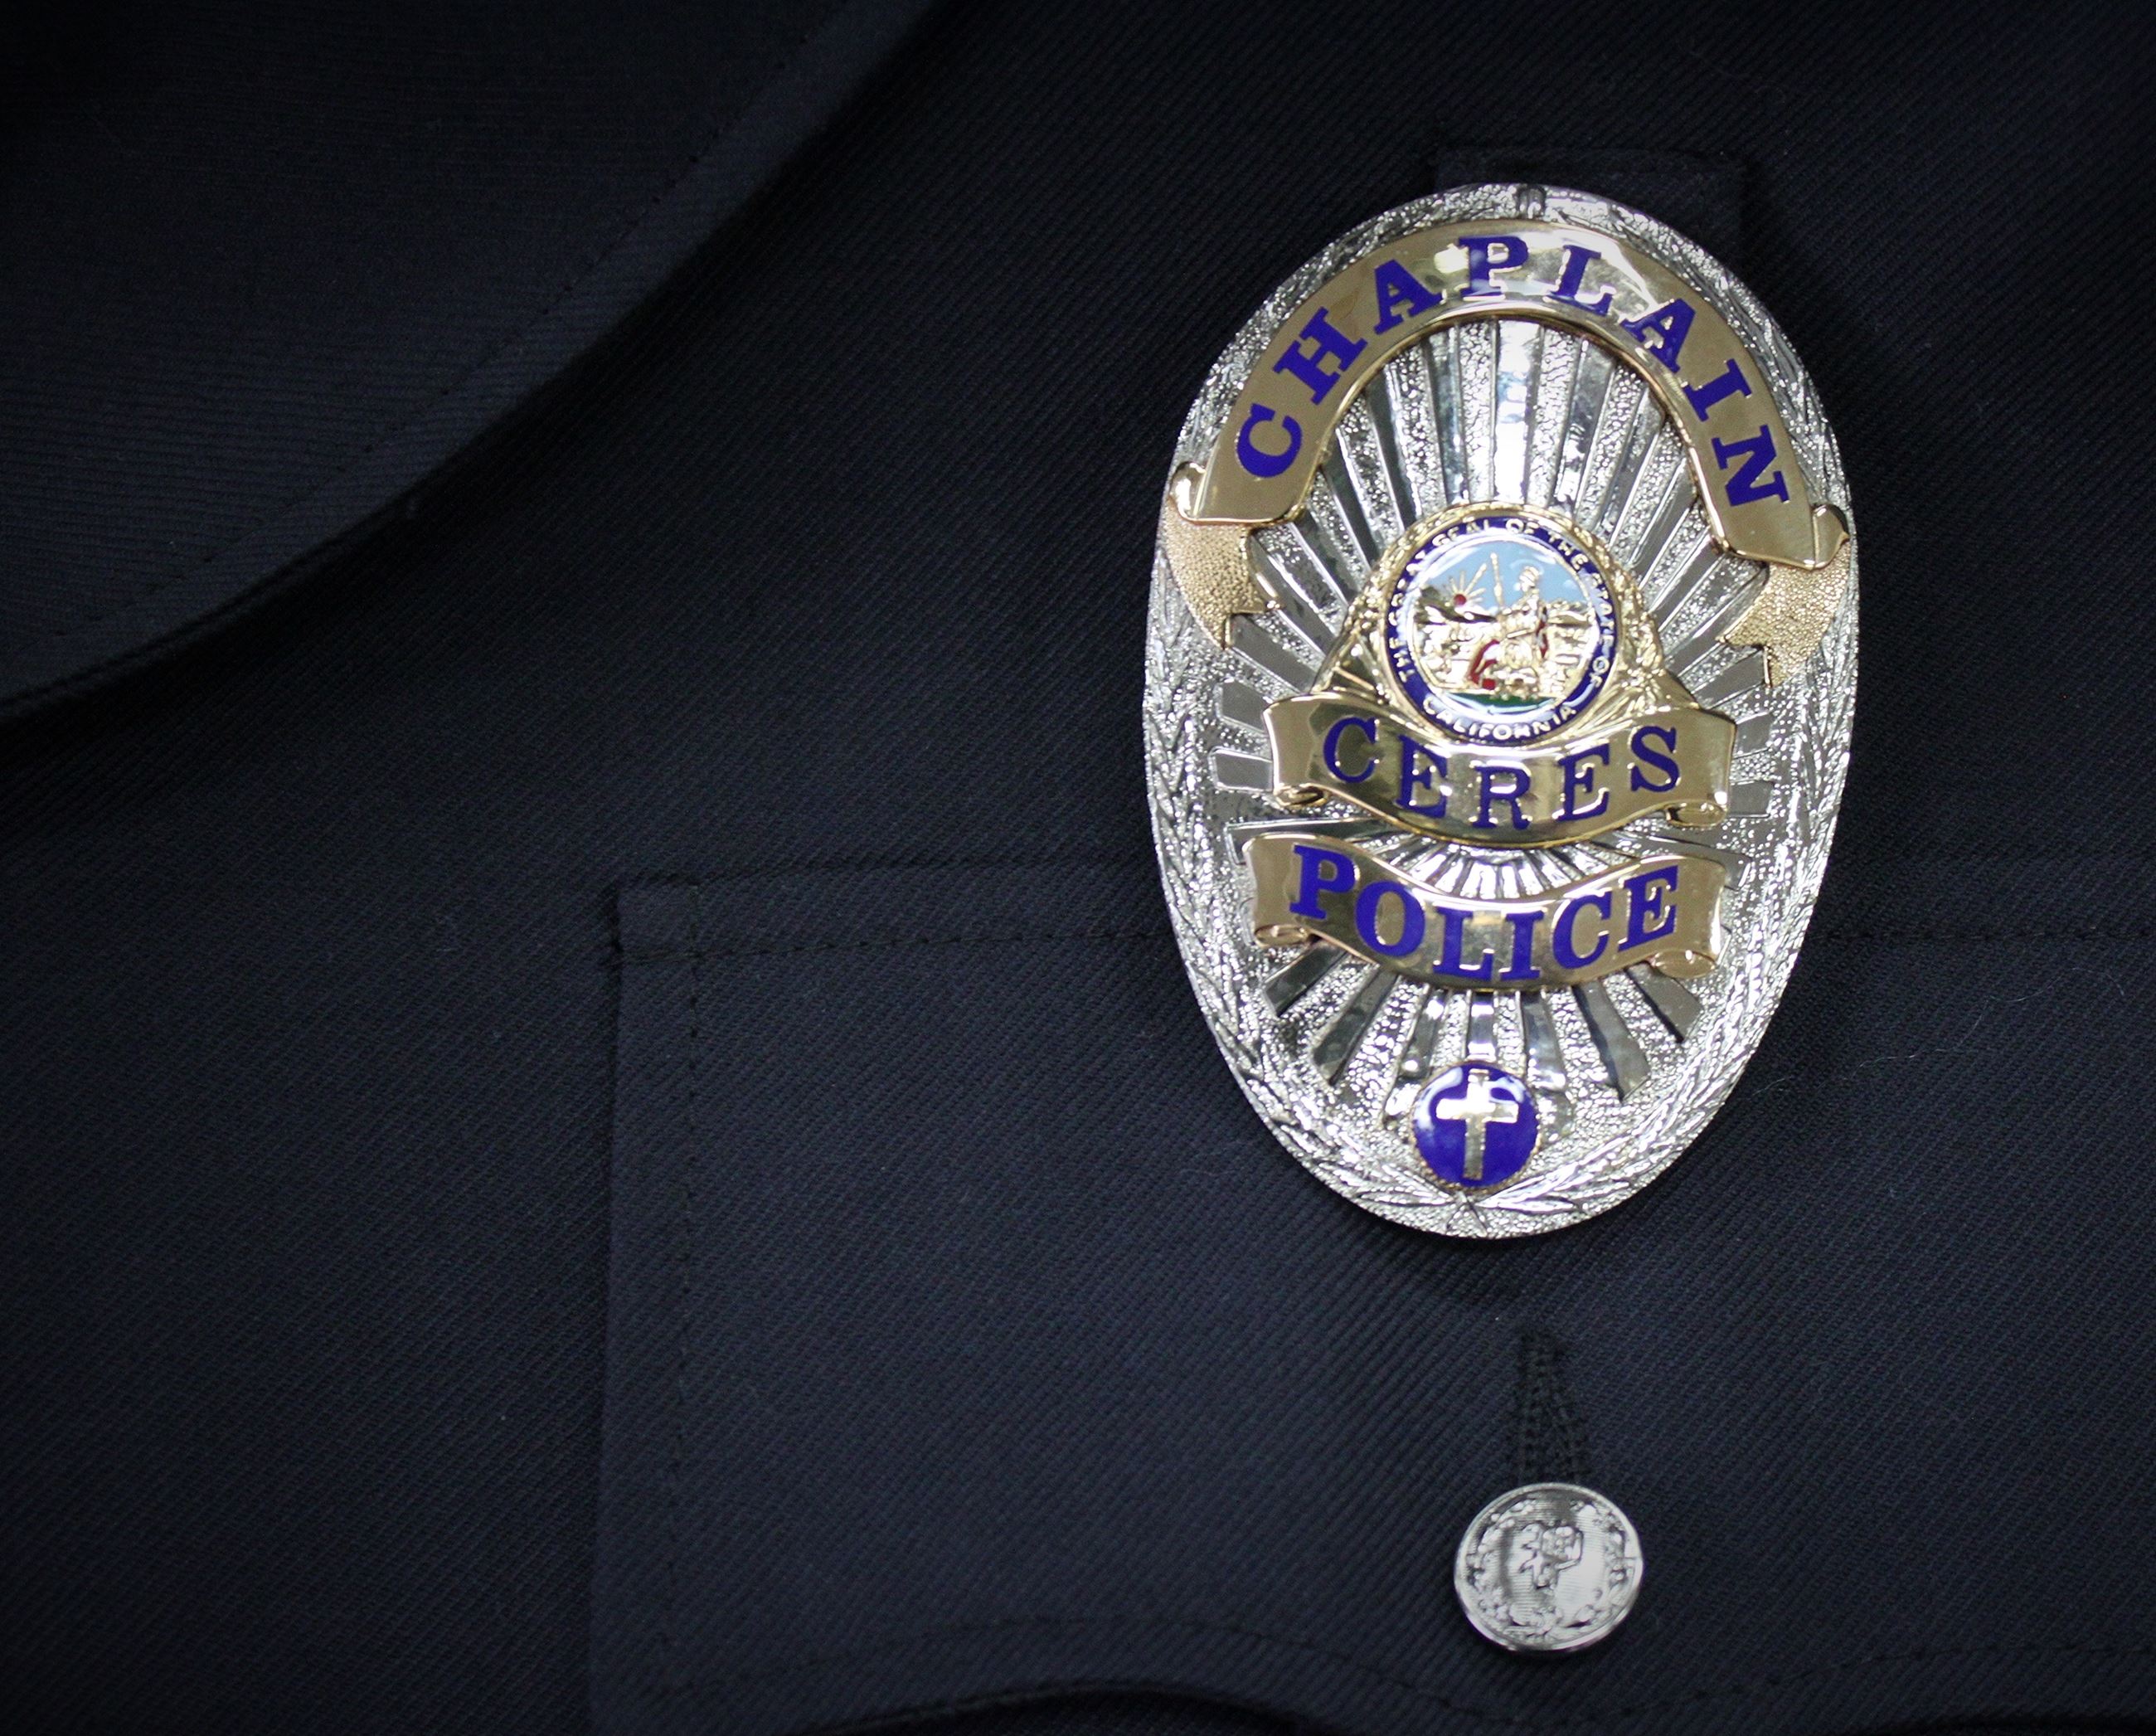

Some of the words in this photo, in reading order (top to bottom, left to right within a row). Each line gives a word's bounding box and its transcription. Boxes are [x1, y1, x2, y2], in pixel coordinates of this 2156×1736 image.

[1236, 234, 1790, 507] CHAPLAIN
[1388, 636, 1415, 683] THE
[1504, 518, 1540, 537] OF
[1548, 532, 1590, 571] THE
[1590, 656, 1610, 688] OF
[1323, 716, 1681, 829] CERES
[1422, 697, 1577, 741] CALIFORNIA
[1289, 844, 1679, 981] POLICE
